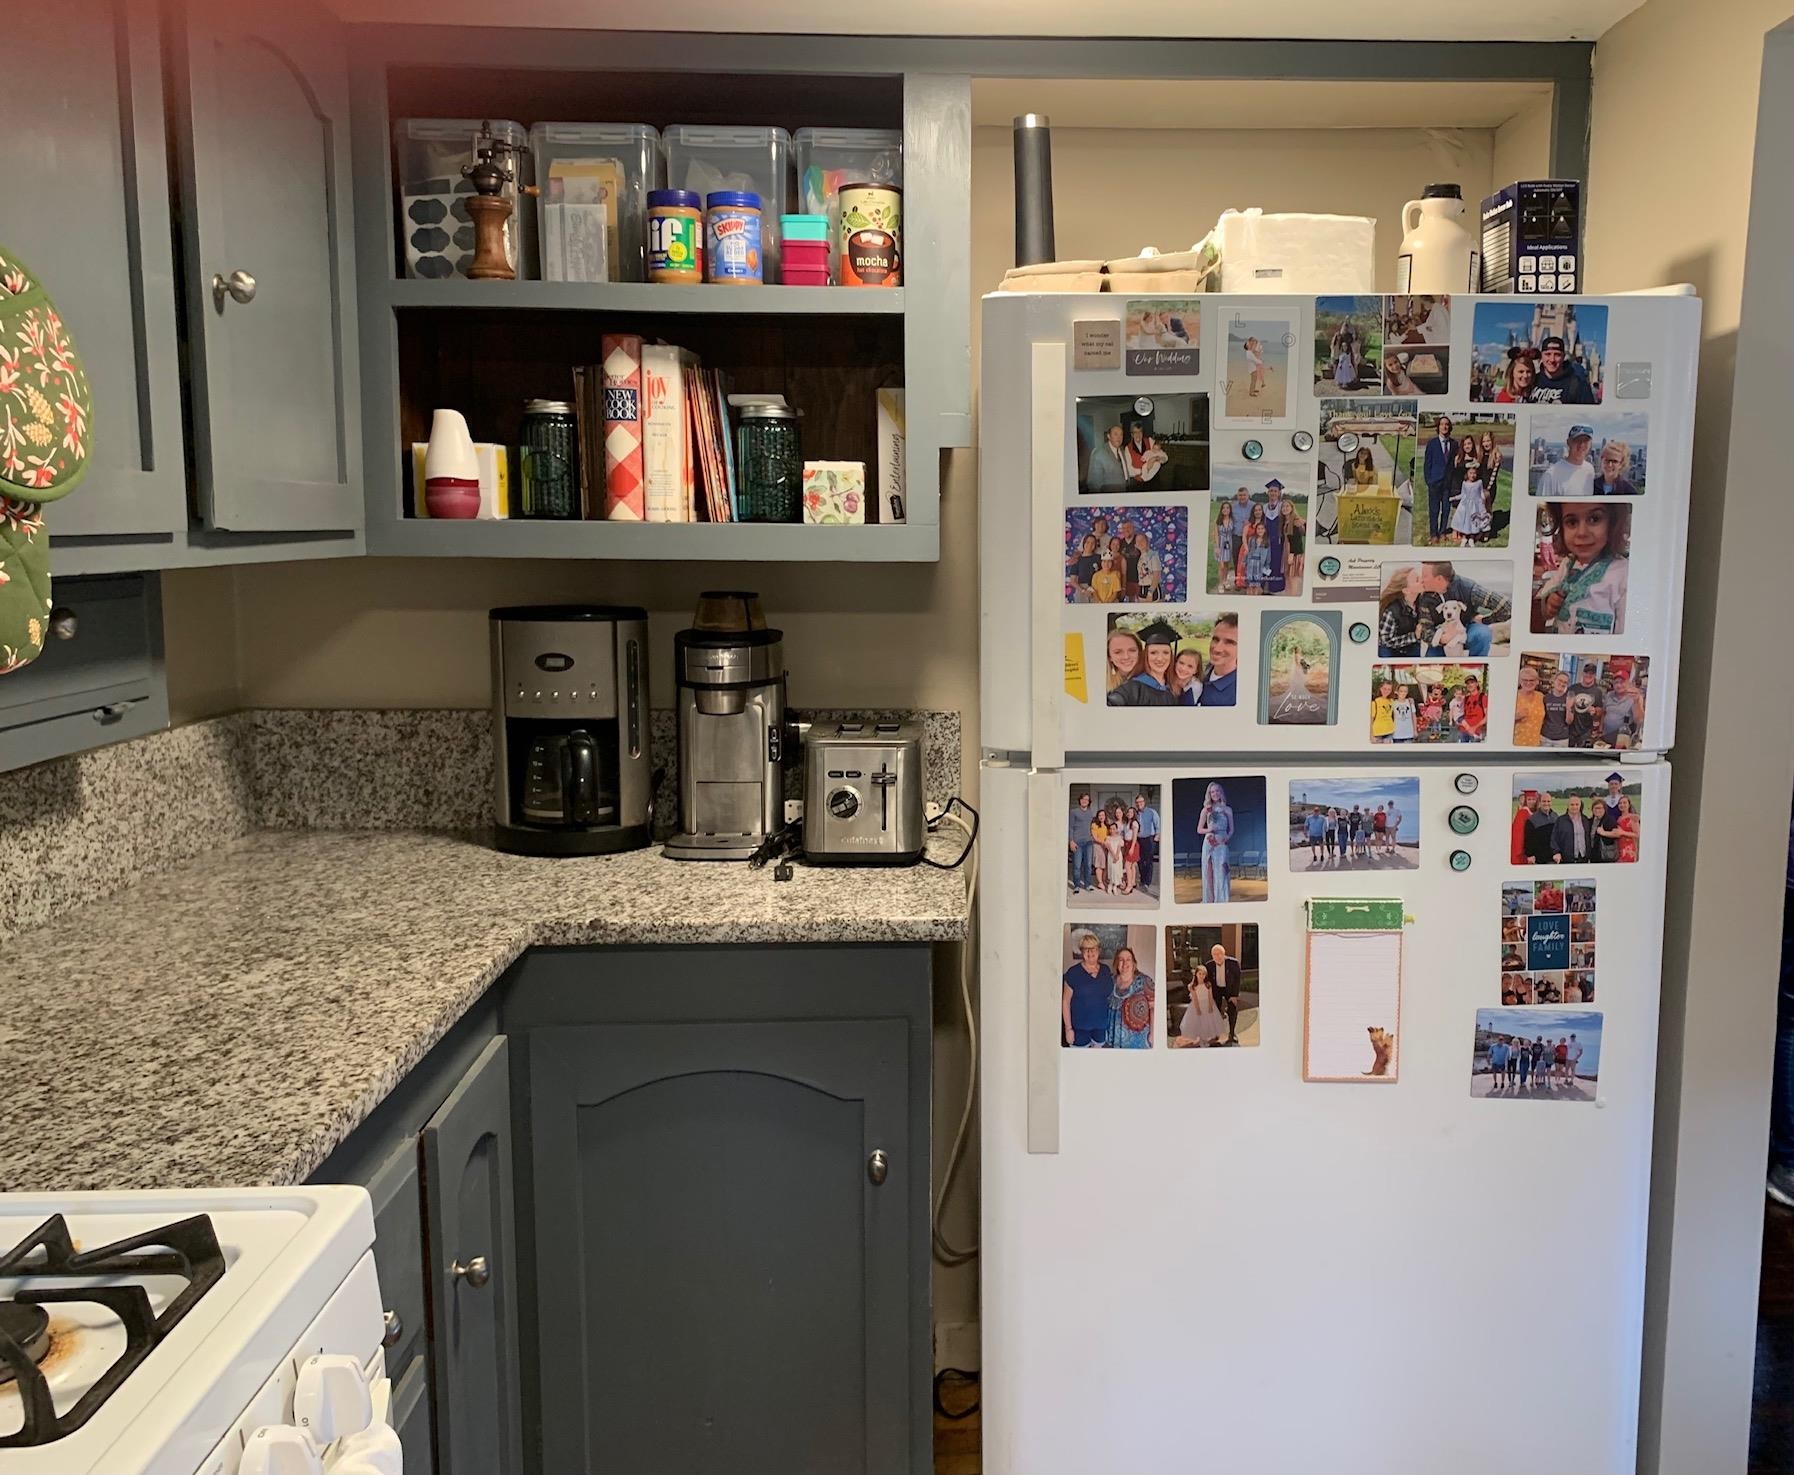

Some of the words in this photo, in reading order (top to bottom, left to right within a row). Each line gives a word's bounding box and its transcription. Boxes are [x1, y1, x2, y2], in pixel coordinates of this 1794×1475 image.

[717, 220, 743, 236] SKIPPY
[648, 218, 683, 252] if
[856, 255, 888, 268] mocha
[607, 389, 634, 400] NEW
[642, 369, 667, 419] joy
[605, 399, 636, 410] COOK
[606, 409, 637, 420] BOOK
[1273, 692, 1320, 720] Love
[1538, 920, 1560, 931] LOVE
[1532, 930, 1566, 945] laughter
[1532, 942, 1565, 952] FAMILY
